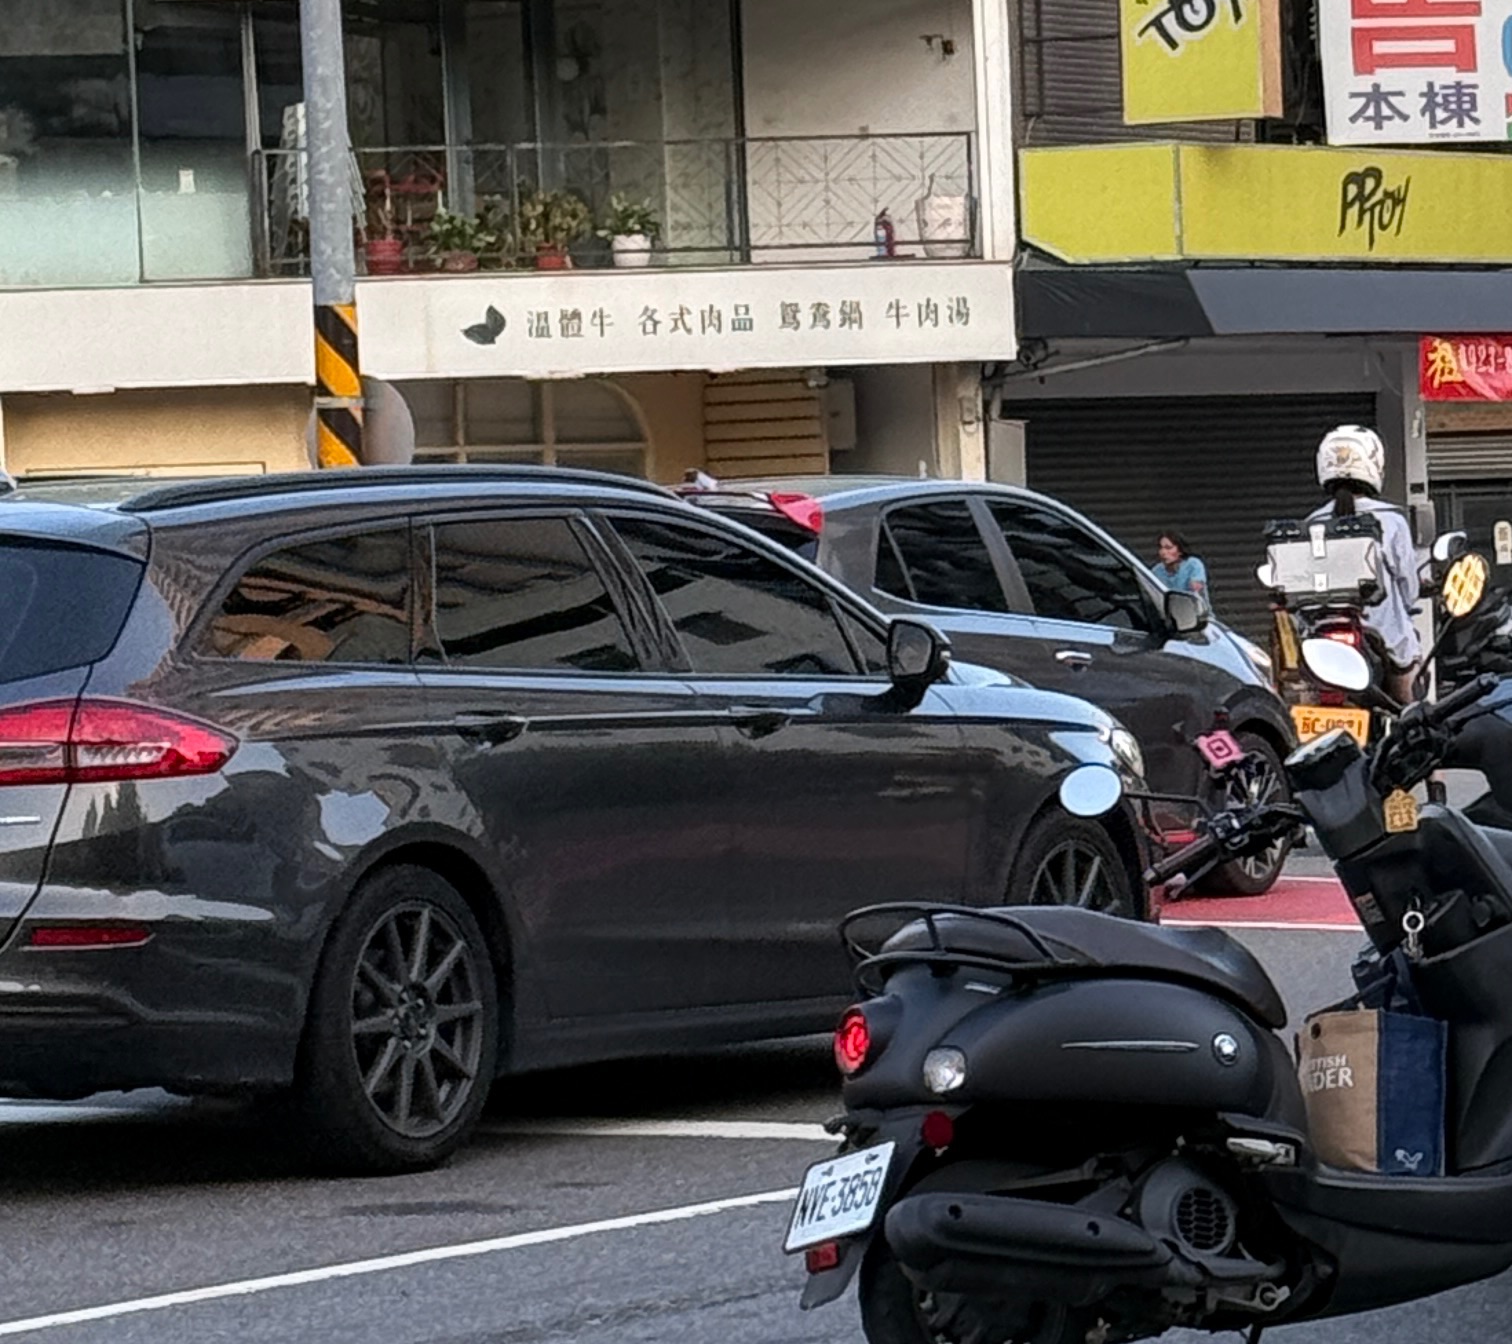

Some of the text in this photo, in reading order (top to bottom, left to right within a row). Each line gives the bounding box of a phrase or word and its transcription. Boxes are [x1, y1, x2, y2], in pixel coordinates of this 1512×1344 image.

[1348, 79, 1481, 131] 本棟
[526, 295, 972, 340] 溫體牛 各式肉品 鴛鴦鍋 牛肉湯
